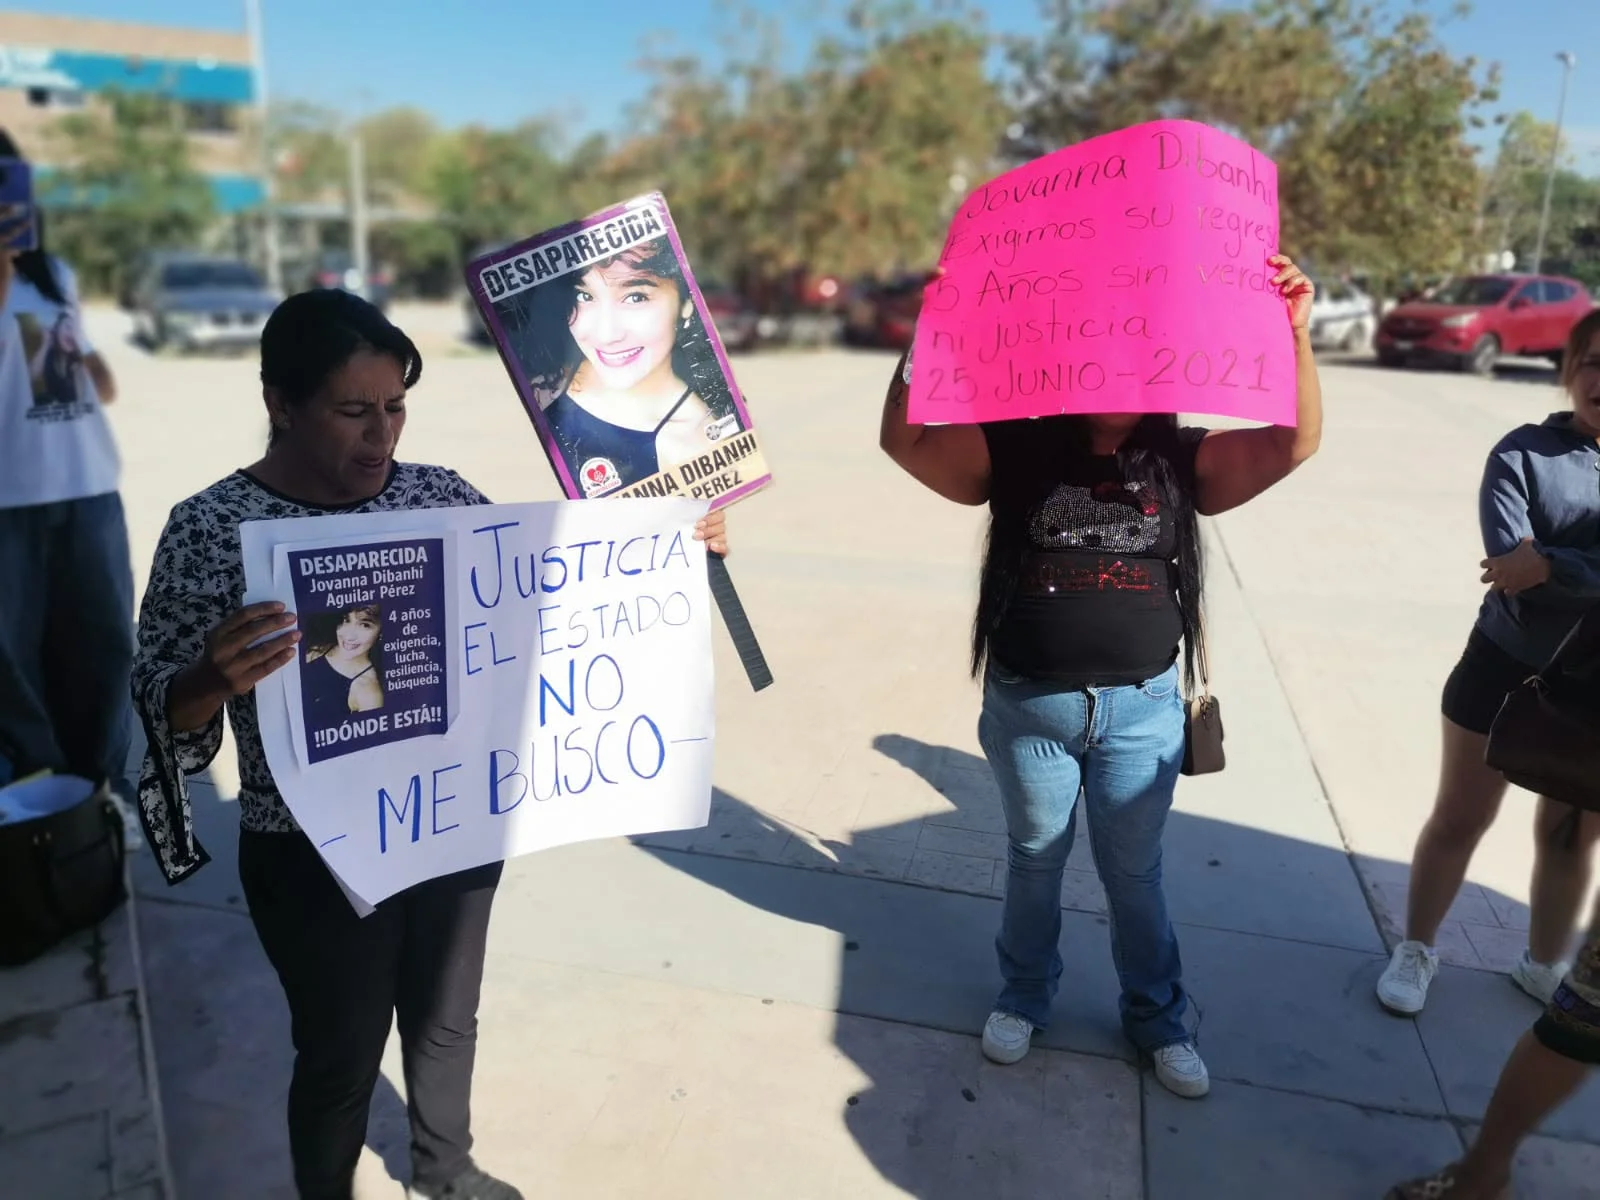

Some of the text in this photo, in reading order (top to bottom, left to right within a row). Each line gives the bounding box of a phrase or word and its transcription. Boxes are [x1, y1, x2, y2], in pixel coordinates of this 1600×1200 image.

[966, 154, 1128, 219] Jovanna
[481, 208, 662, 298] DESAPARECIDA
[943, 218, 1096, 268] Exigimos
[933, 276, 960, 311] 5
[977, 269, 1083, 307] Años
[1107, 257, 1168, 289] sin
[932, 325, 965, 352] ni
[926, 367, 979, 403] 25
[1145, 348, 1272, 393] 2021
[679, 433, 757, 485] DIBANHI
[300, 545, 428, 576] DESAPARECIDA
[310, 565, 424, 593] Jovanna Dibanhi
[326, 583, 415, 609] Aguilar Pérez
[388, 607, 431, 623] 4 años
[383, 634, 442, 654] exigencia,
[402, 622, 418, 636] de
[464, 591, 692, 676] EL ESTADO
[385, 661, 443, 679] resiliencia,
[394, 649, 430, 665] lucha,
[387, 674, 440, 692] búsqueda
[538, 653, 624, 728] NO
[314, 703, 442, 749] !!DÓNDE ESTÁ!!
[377, 763, 463, 854] ME
[488, 714, 665, 815] BUSCO
